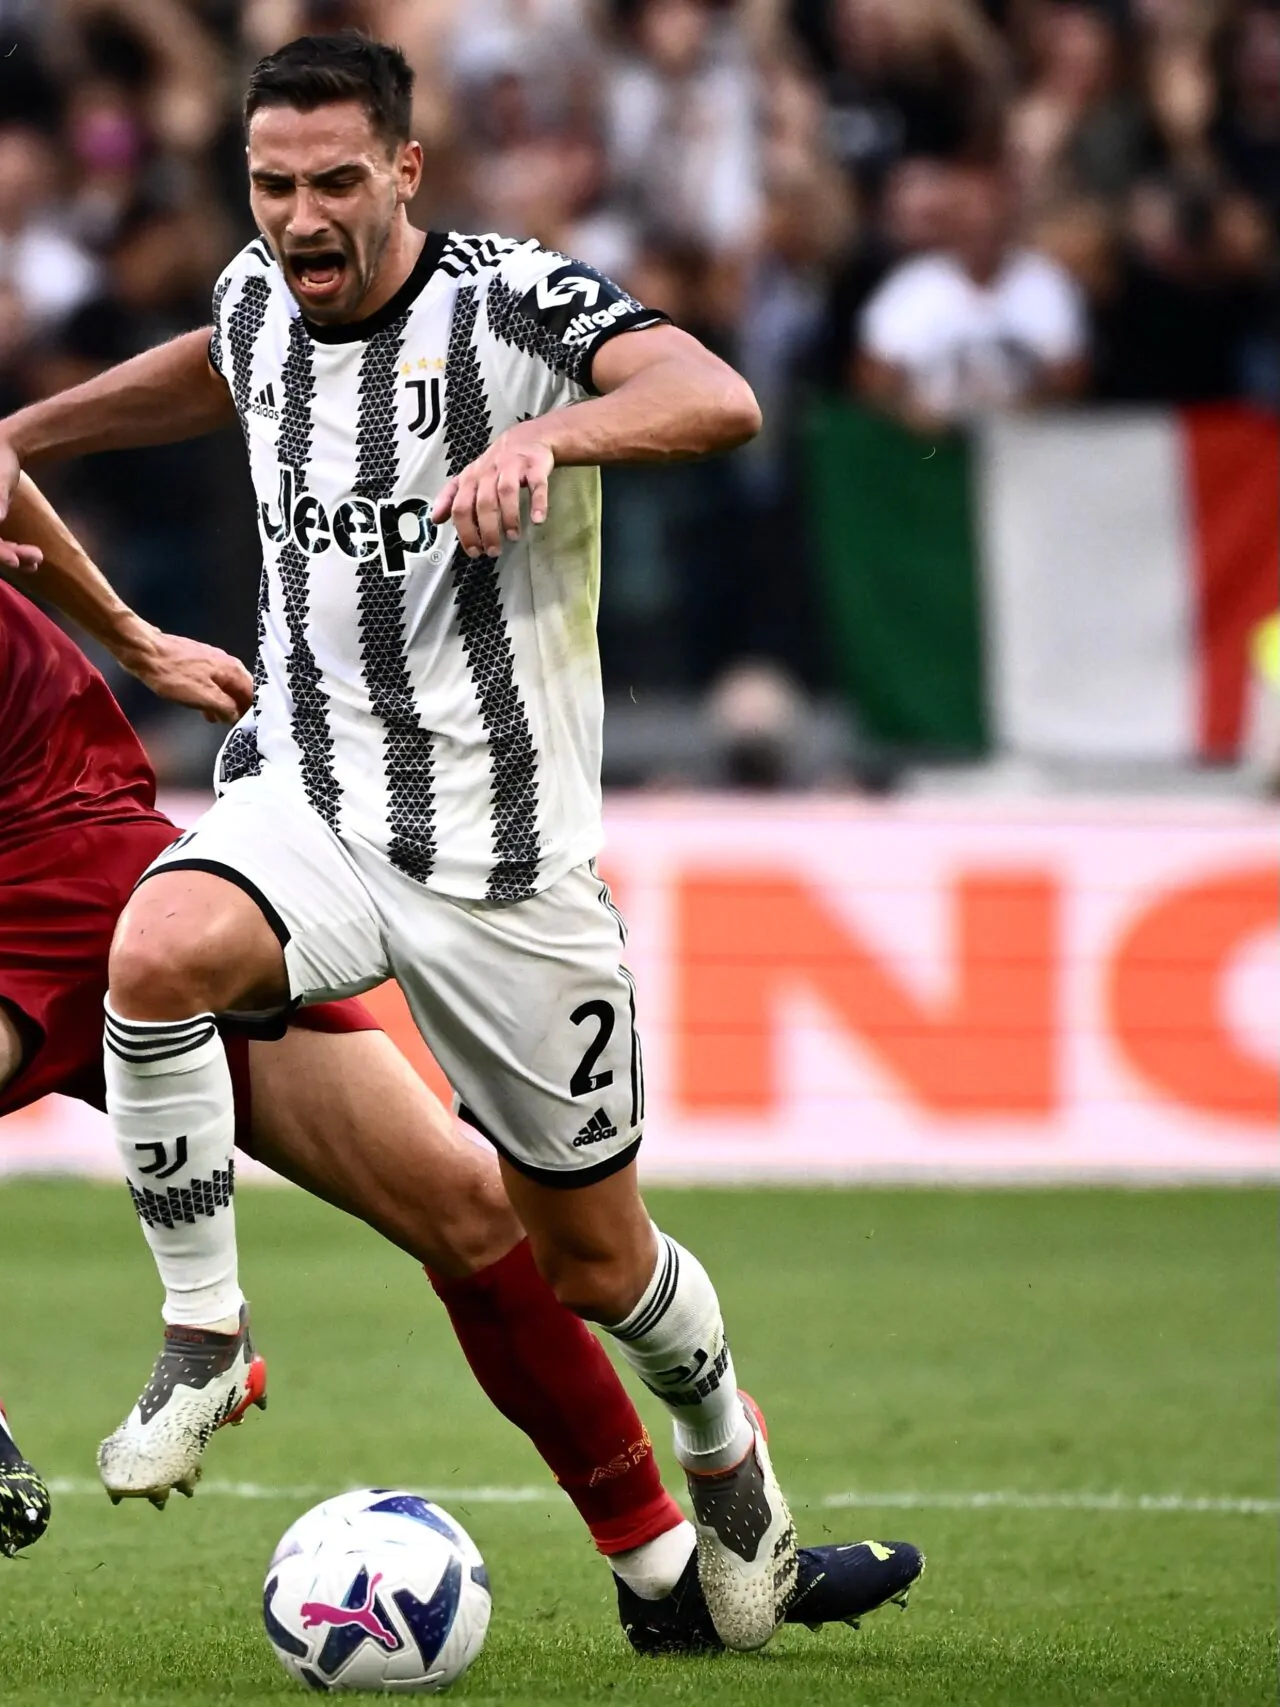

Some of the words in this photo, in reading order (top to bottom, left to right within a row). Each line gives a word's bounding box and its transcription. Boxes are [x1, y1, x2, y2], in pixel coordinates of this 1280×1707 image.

[251, 403, 280, 421] adidas
[261, 468, 439, 573] Jeep
[569, 999, 616, 1098] 2
[572, 1126, 618, 1148] adidas
